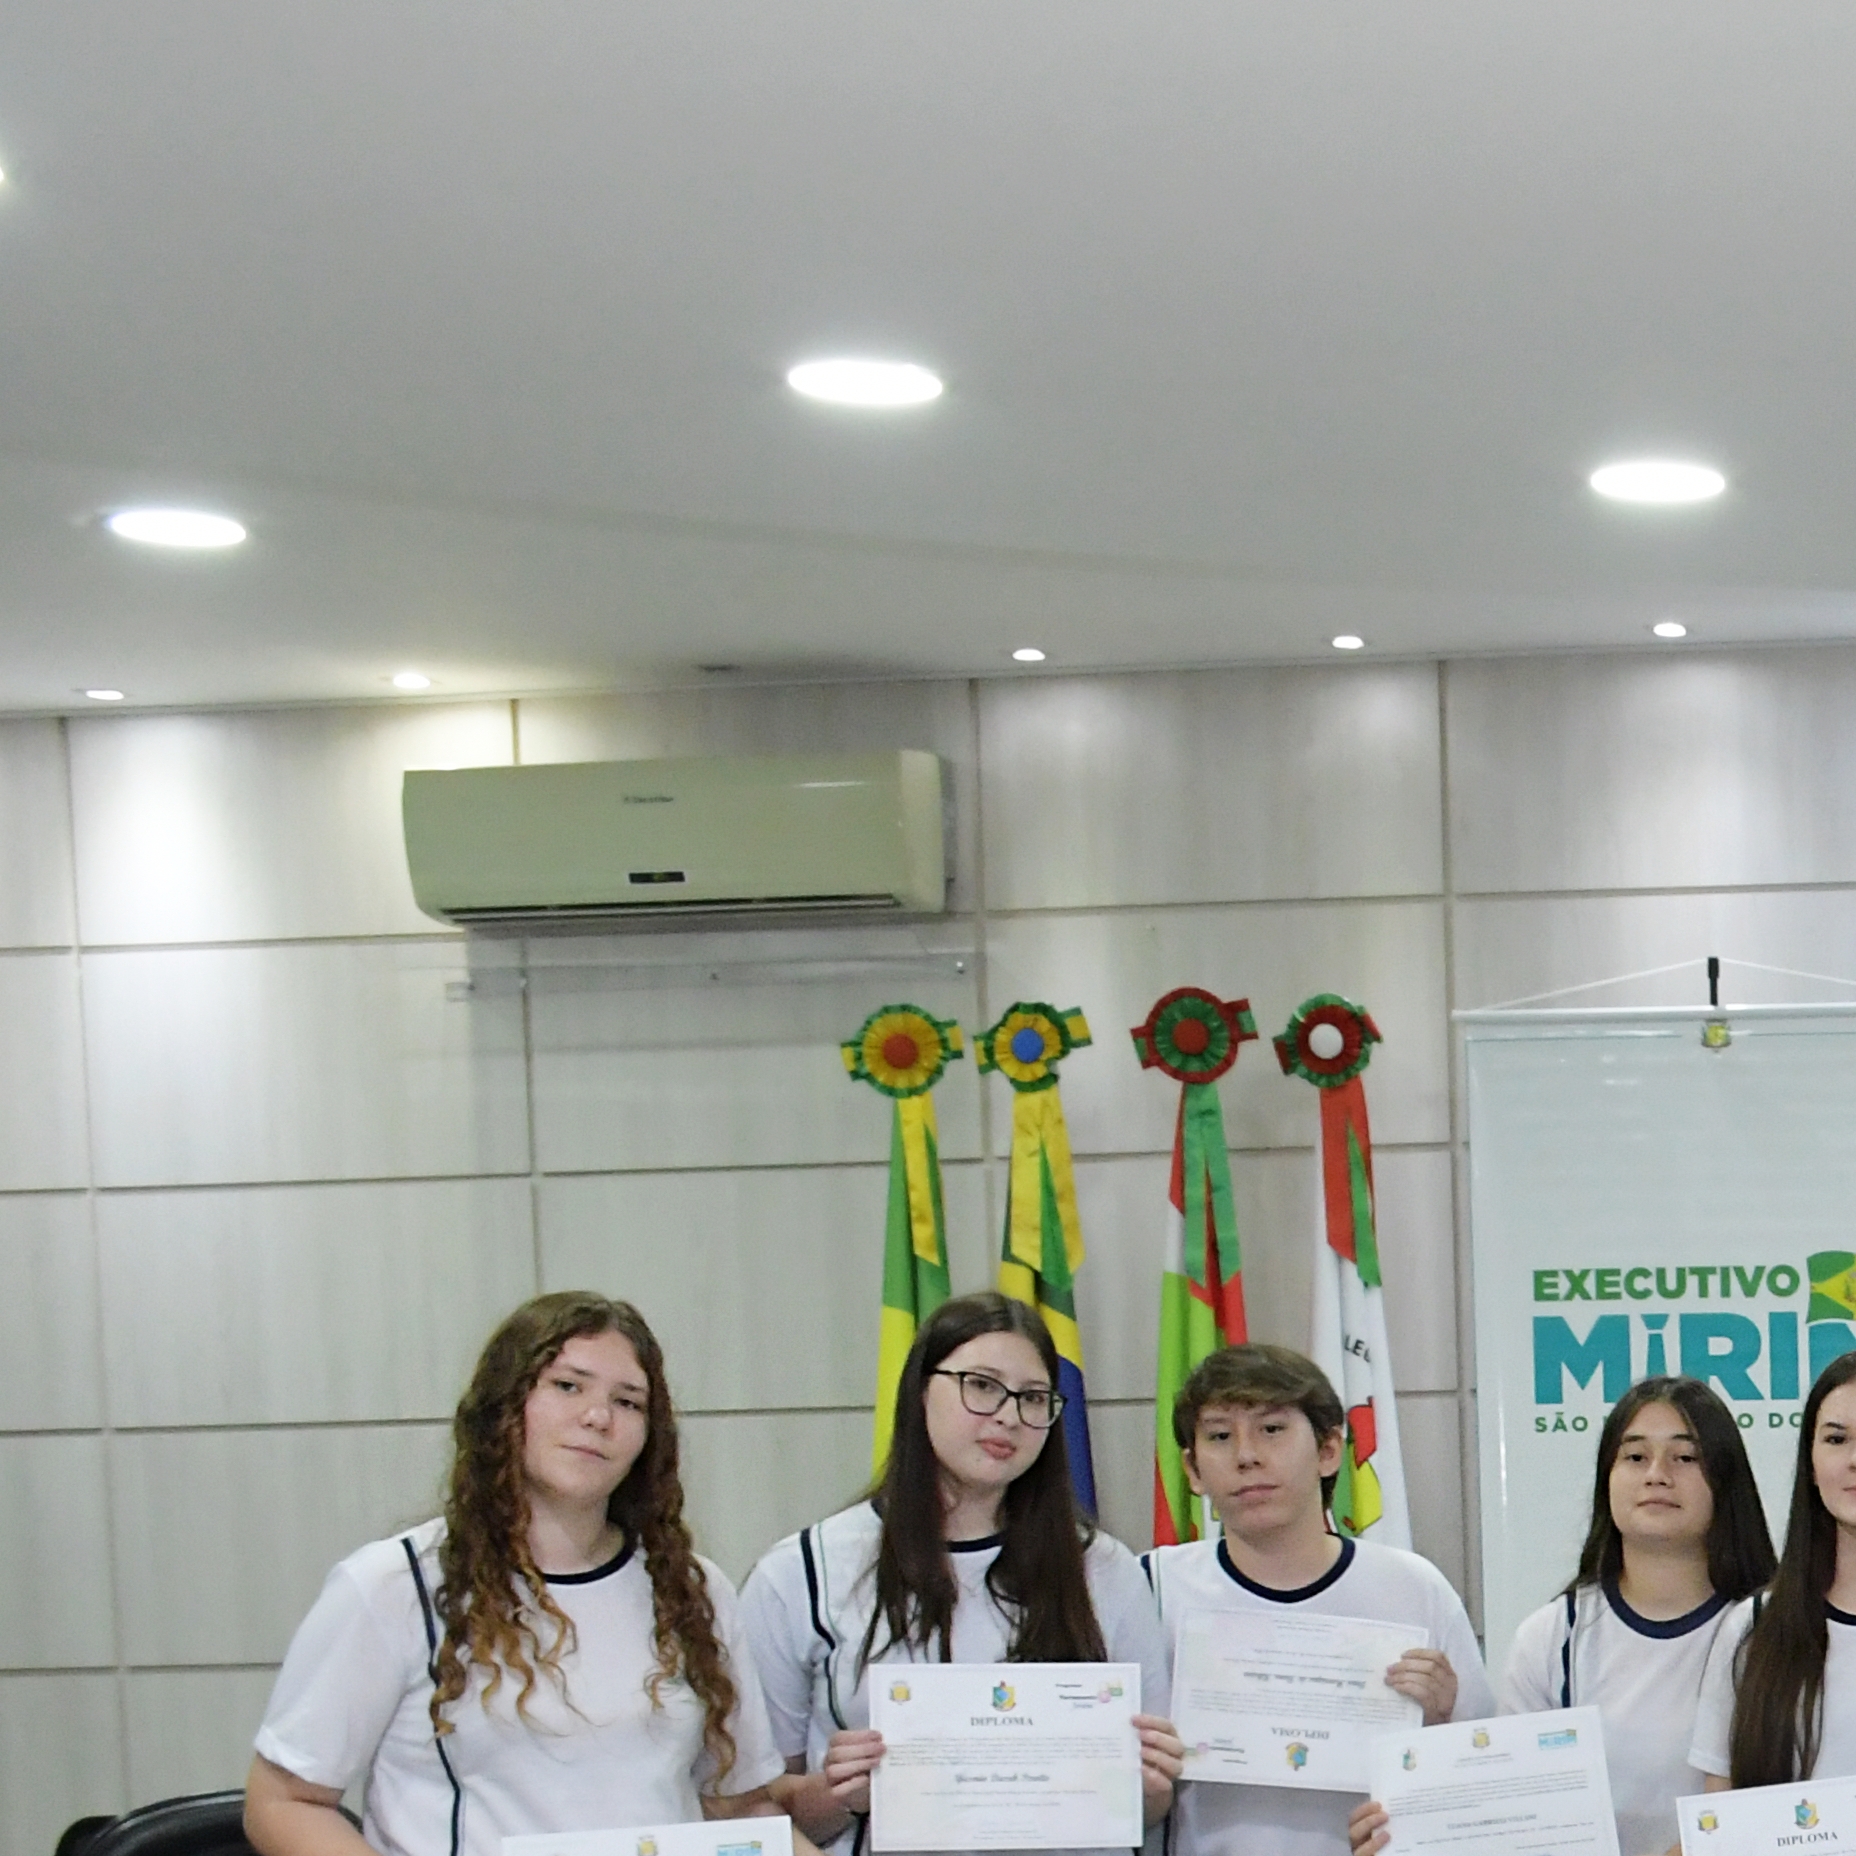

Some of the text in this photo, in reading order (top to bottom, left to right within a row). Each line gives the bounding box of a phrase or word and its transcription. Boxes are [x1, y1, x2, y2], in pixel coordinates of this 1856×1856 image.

[1533, 1264, 1800, 1302] EXECUTIVO
[1534, 1412, 1588, 1434] SÃO
[970, 1716, 1033, 1727] DIPLOMA
[1777, 1831, 1838, 1847] DIPLOMA
